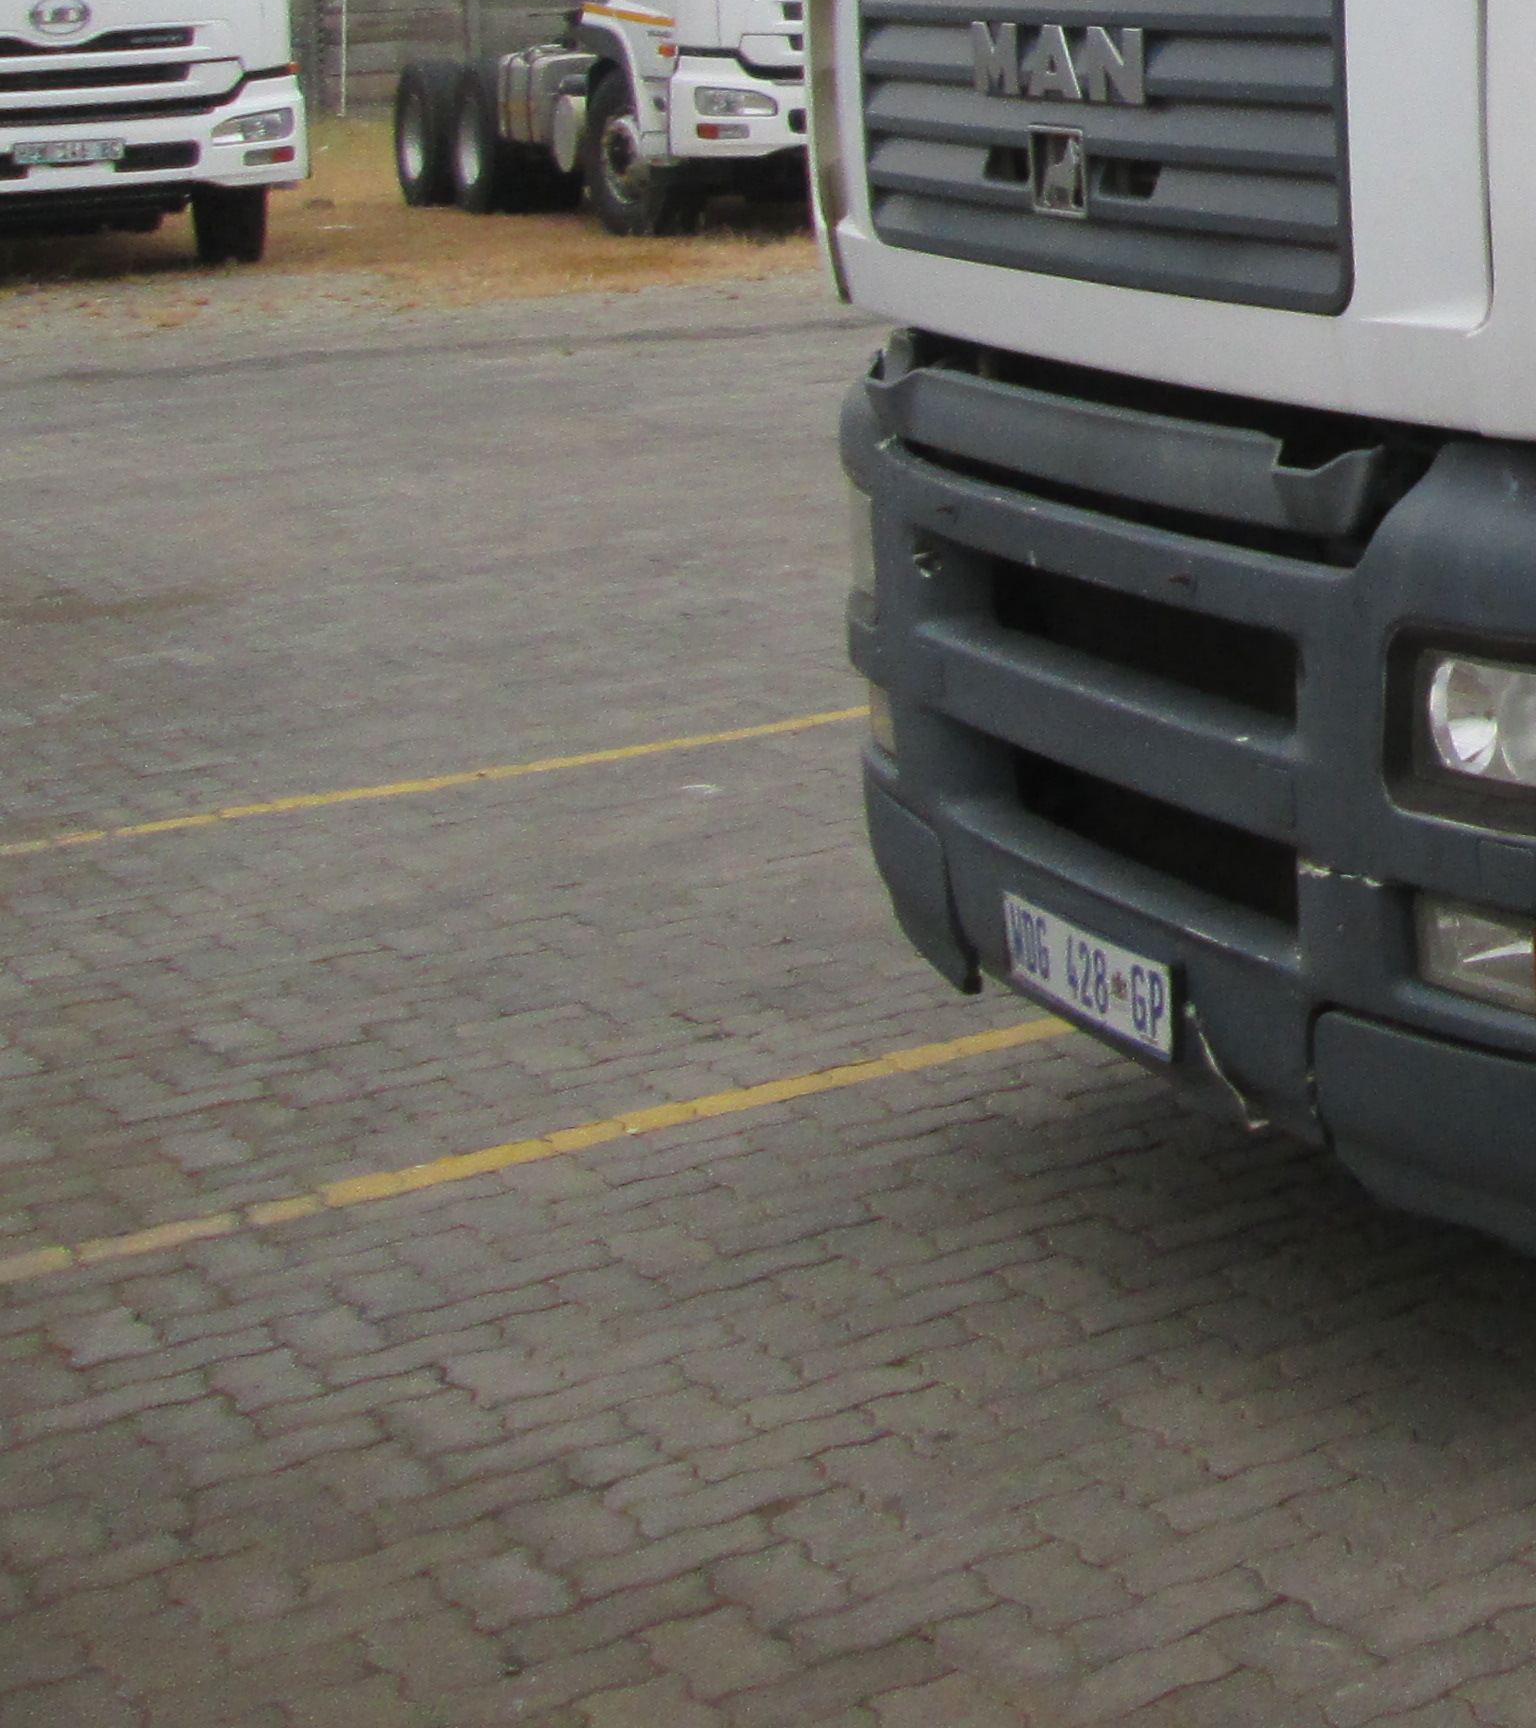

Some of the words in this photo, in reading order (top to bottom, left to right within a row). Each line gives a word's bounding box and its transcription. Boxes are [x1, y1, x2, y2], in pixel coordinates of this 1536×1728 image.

[972, 21, 1146, 105] MAN
[1066, 935, 1110, 1015] 428
[1131, 963, 1165, 1040] GP
